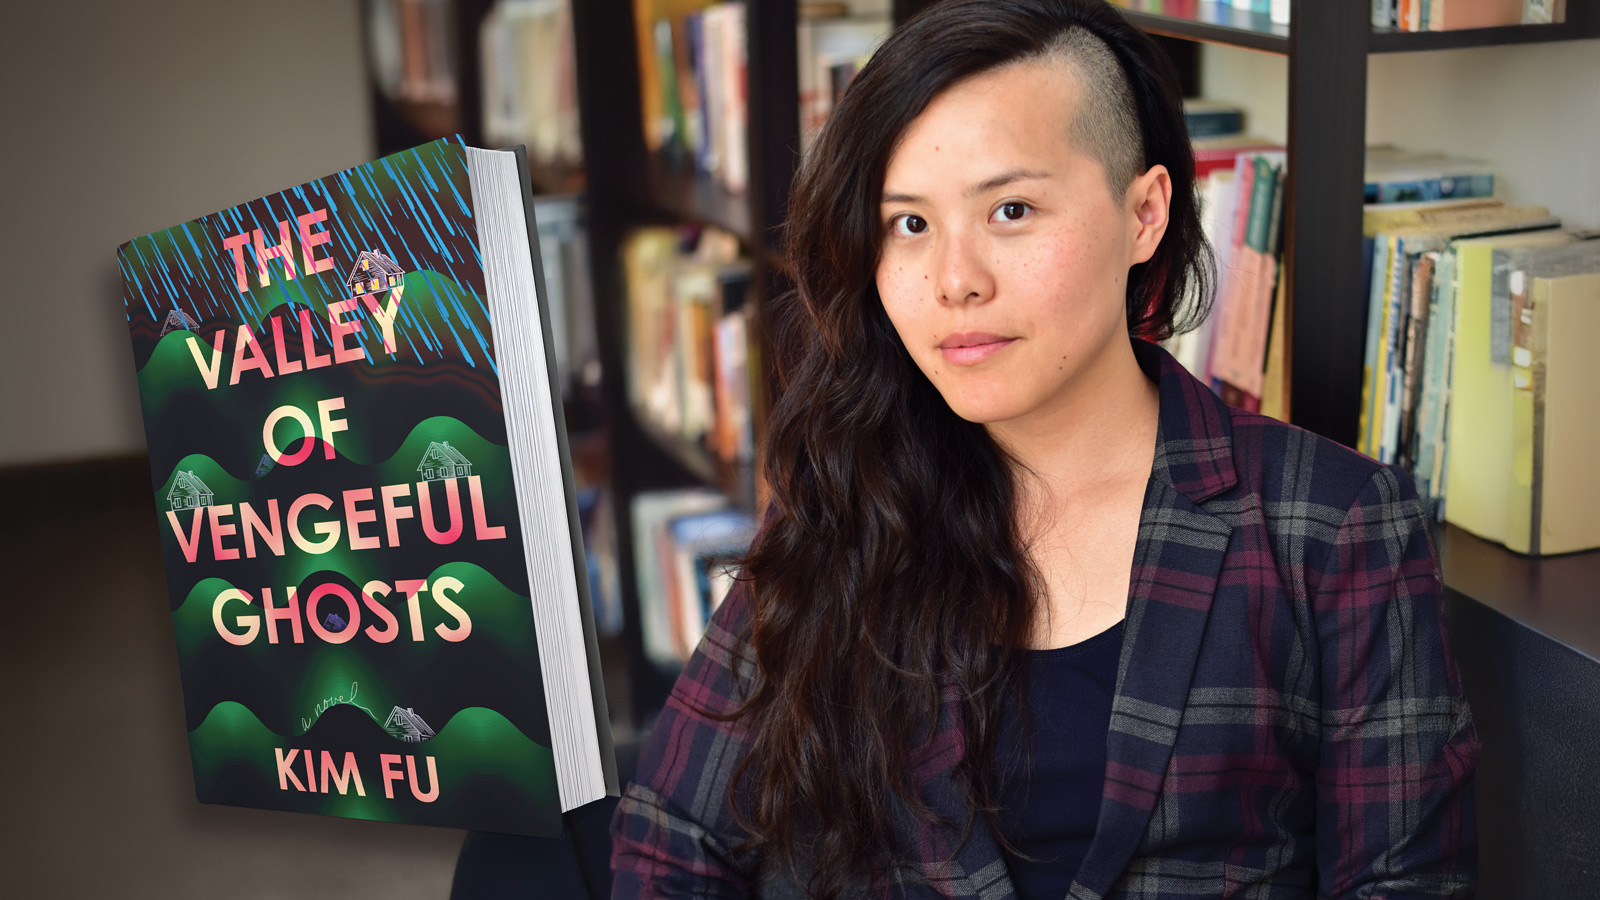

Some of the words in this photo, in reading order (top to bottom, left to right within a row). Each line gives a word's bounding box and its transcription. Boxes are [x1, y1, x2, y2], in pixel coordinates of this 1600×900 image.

[223, 208, 335, 293] THE
[186, 284, 405, 390] VALLEY
[262, 396, 349, 467] OF
[166, 475, 506, 563] VENGEFUL
[211, 576, 472, 646] GHOSTS
[301, 717, 312, 732] a
[314, 681, 379, 721] novel
[274, 747, 366, 797] KIM
[379, 753, 440, 803] FU
